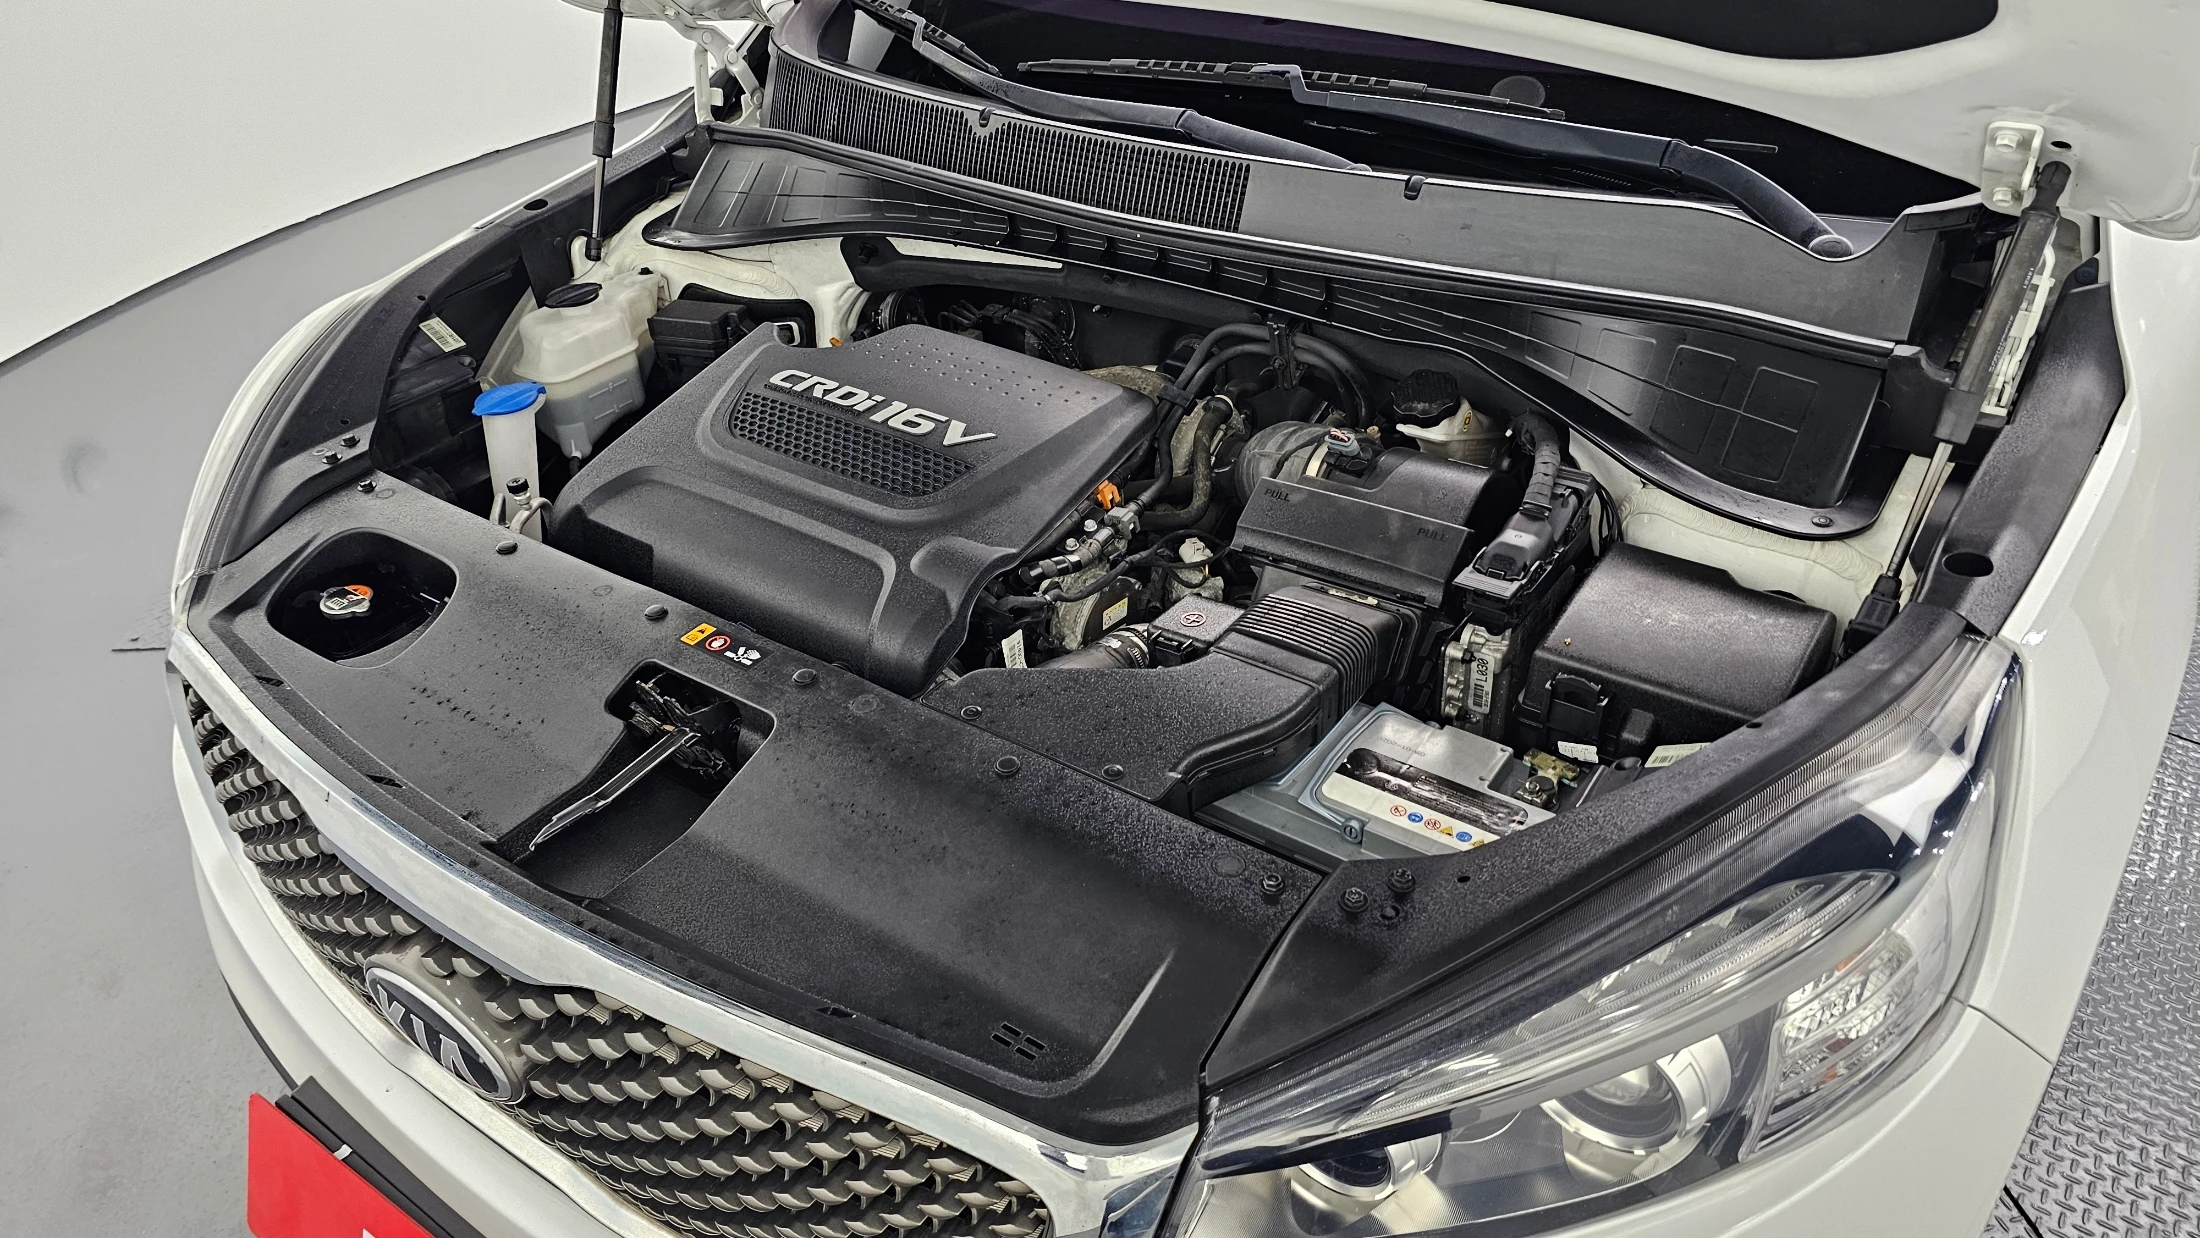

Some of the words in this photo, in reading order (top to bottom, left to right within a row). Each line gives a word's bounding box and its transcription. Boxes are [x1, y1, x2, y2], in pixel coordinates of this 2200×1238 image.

[769, 369, 886, 412] CRDi
[1264, 488, 1290, 502] PULL
[1416, 527, 1448, 543] PULL
[1475, 657, 1489, 683] L030
[376, 983, 485, 1092] KIA
